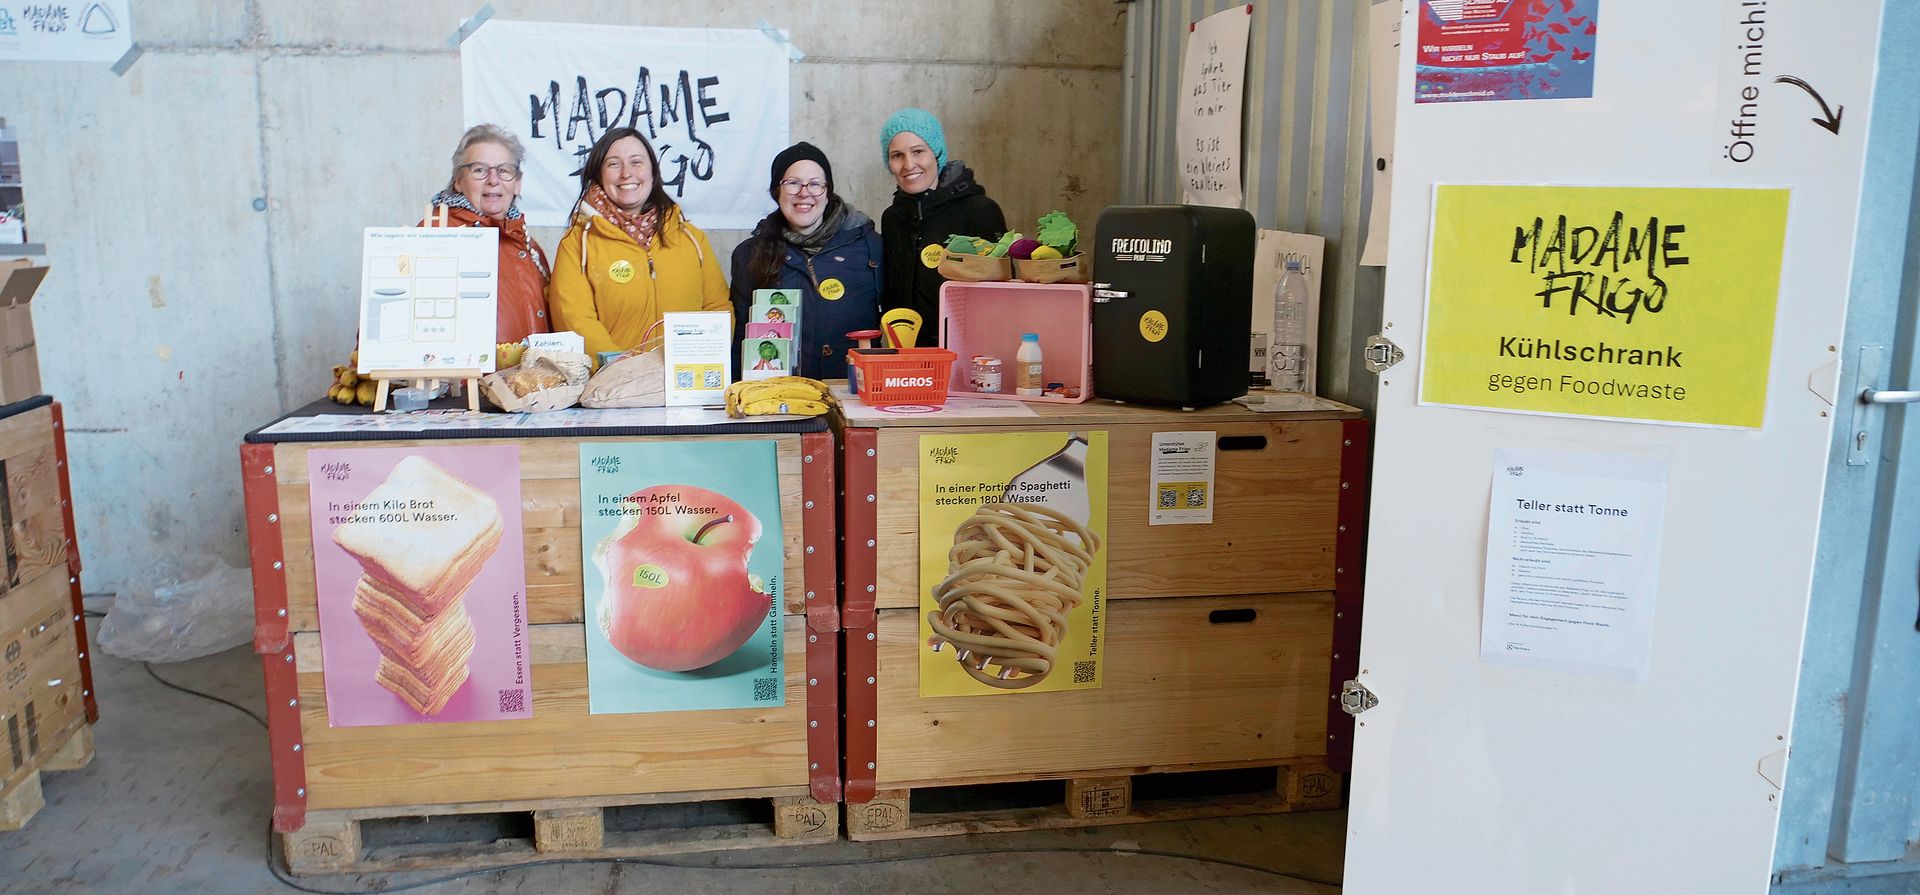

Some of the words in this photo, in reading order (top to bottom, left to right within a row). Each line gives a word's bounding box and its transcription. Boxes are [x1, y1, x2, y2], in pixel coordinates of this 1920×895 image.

[1738, 1, 1766, 76] mich!
[1210, 77, 1232, 93] Tier
[530, 66, 730, 149] MADAME
[1194, 101, 1204, 117] in
[1723, 86, 1759, 163] Öffne
[1207, 135, 1221, 152] ist
[569, 144, 715, 198] FGO
[1111, 238, 1172, 255] FRESCOLINO
[1510, 211, 1690, 279] MADAME
[1534, 271, 1668, 324] FRIGO
[1499, 336, 1683, 368] Kühlschrank
[885, 376, 934, 388] MIGROS
[1488, 372, 1552, 393] gegen
[1559, 375, 1686, 401] Foodwaste
[929, 446, 959, 457] MADAME
[935, 484, 946, 493] In
[948, 483, 976, 493] einer
[979, 481, 1017, 492] Portion
[1020, 480, 1071, 492] Spaghetti
[329, 502, 340, 512] In
[343, 500, 380, 511] einem
[383, 500, 406, 510] Kilo
[410, 499, 434, 510] Brot
[598, 494, 608, 504] In
[612, 493, 647, 504] einem
[649, 493, 681, 505] Apfel
[935, 494, 977, 505] stecken
[980, 494, 1005, 504] 180L
[1007, 493, 1048, 503] Wasser.
[1516, 498, 1552, 512] Teller
[1554, 503, 1584, 514] statt
[1588, 503, 1629, 517] Tonne
[329, 513, 375, 525] stecken
[379, 513, 409, 523] 600L
[413, 511, 458, 522] Wasser.
[598, 507, 643, 517] stecken
[646, 506, 672, 516] 150L
[675, 505, 719, 515] Wasser.
[639, 569, 662, 585] 150L
[769, 575, 777, 618] Gammeln.
[1092, 587, 1100, 614] Tonne.
[513, 592, 522, 639] Vergessen.
[514, 640, 522, 659] statt
[1090, 635, 1098, 657] Teller
[769, 640, 778, 674] Handeln
[515, 661, 523, 684] Essen
